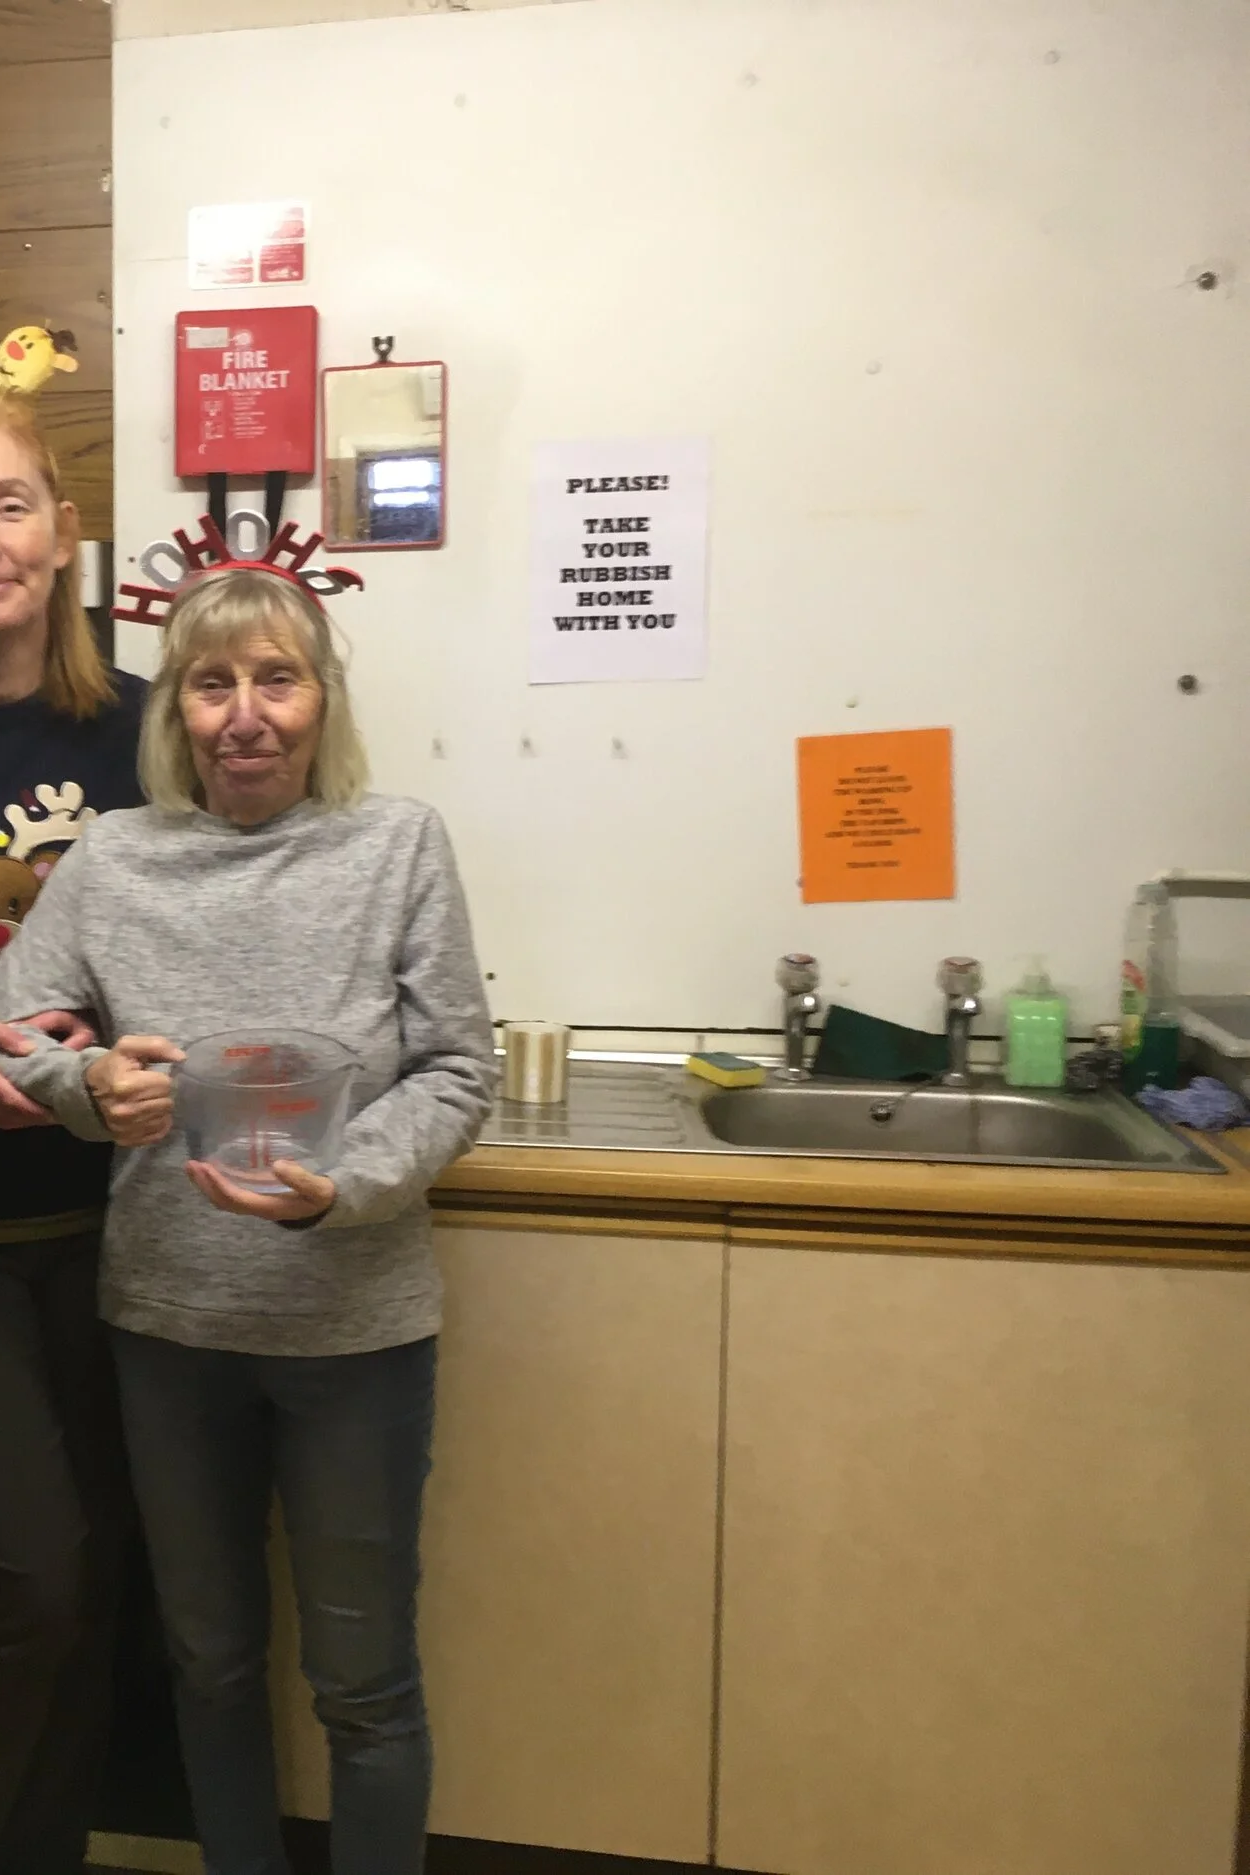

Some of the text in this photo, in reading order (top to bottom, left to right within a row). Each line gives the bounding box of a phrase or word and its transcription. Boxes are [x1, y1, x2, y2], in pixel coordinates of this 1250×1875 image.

[222, 351, 268, 369] FIRE
[199, 370, 290, 391] BLANKET
[566, 475, 670, 494] PLEASE!
[583, 517, 651, 534] TAKE
[582, 542, 651, 558] YOUR
[559, 565, 673, 583] RUBBISH
[576, 590, 654, 607] HOME
[552, 614, 677, 631] WITH YOU
